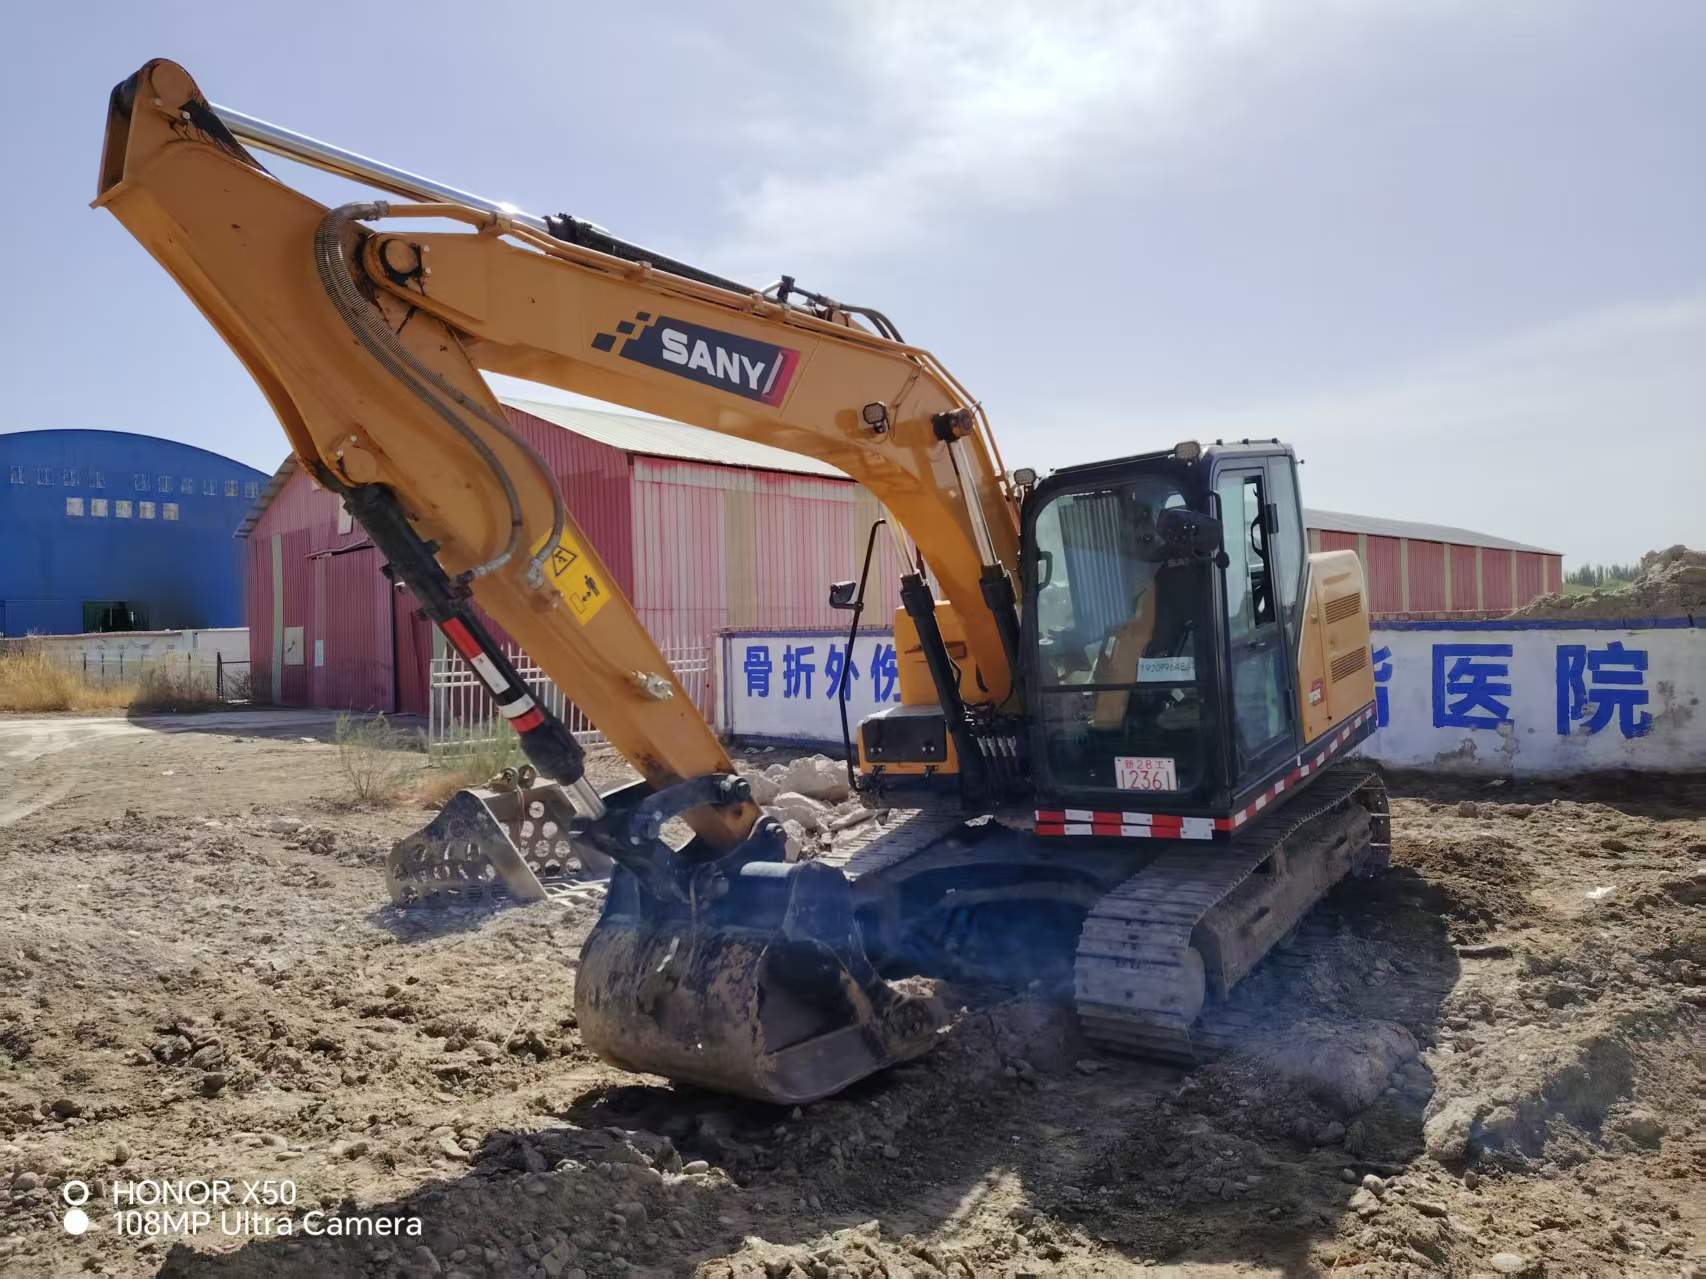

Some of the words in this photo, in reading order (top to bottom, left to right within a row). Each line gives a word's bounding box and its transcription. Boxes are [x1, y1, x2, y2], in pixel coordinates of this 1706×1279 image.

[661, 327, 766, 391] SANY
[743, 643, 901, 703] 骨折外伤
